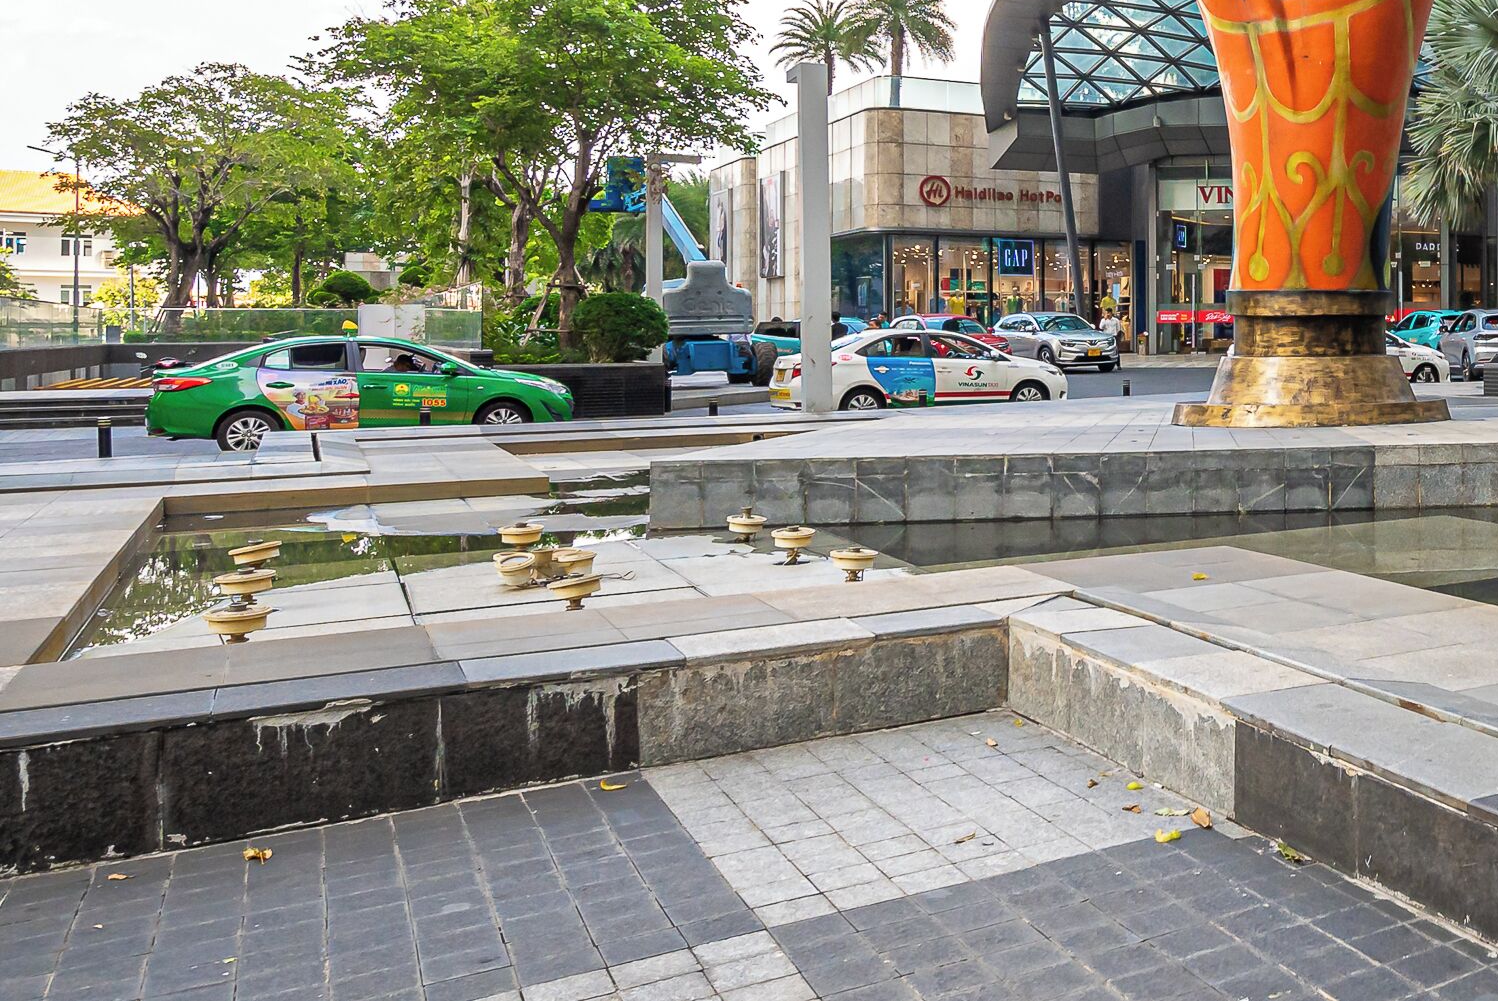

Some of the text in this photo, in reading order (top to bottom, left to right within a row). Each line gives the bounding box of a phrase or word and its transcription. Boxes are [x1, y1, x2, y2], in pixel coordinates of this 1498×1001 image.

[954, 185, 1062, 204] Haidilao HotPo
[1004, 248, 1028, 267] GAP
[422, 398, 446, 408] 1055
